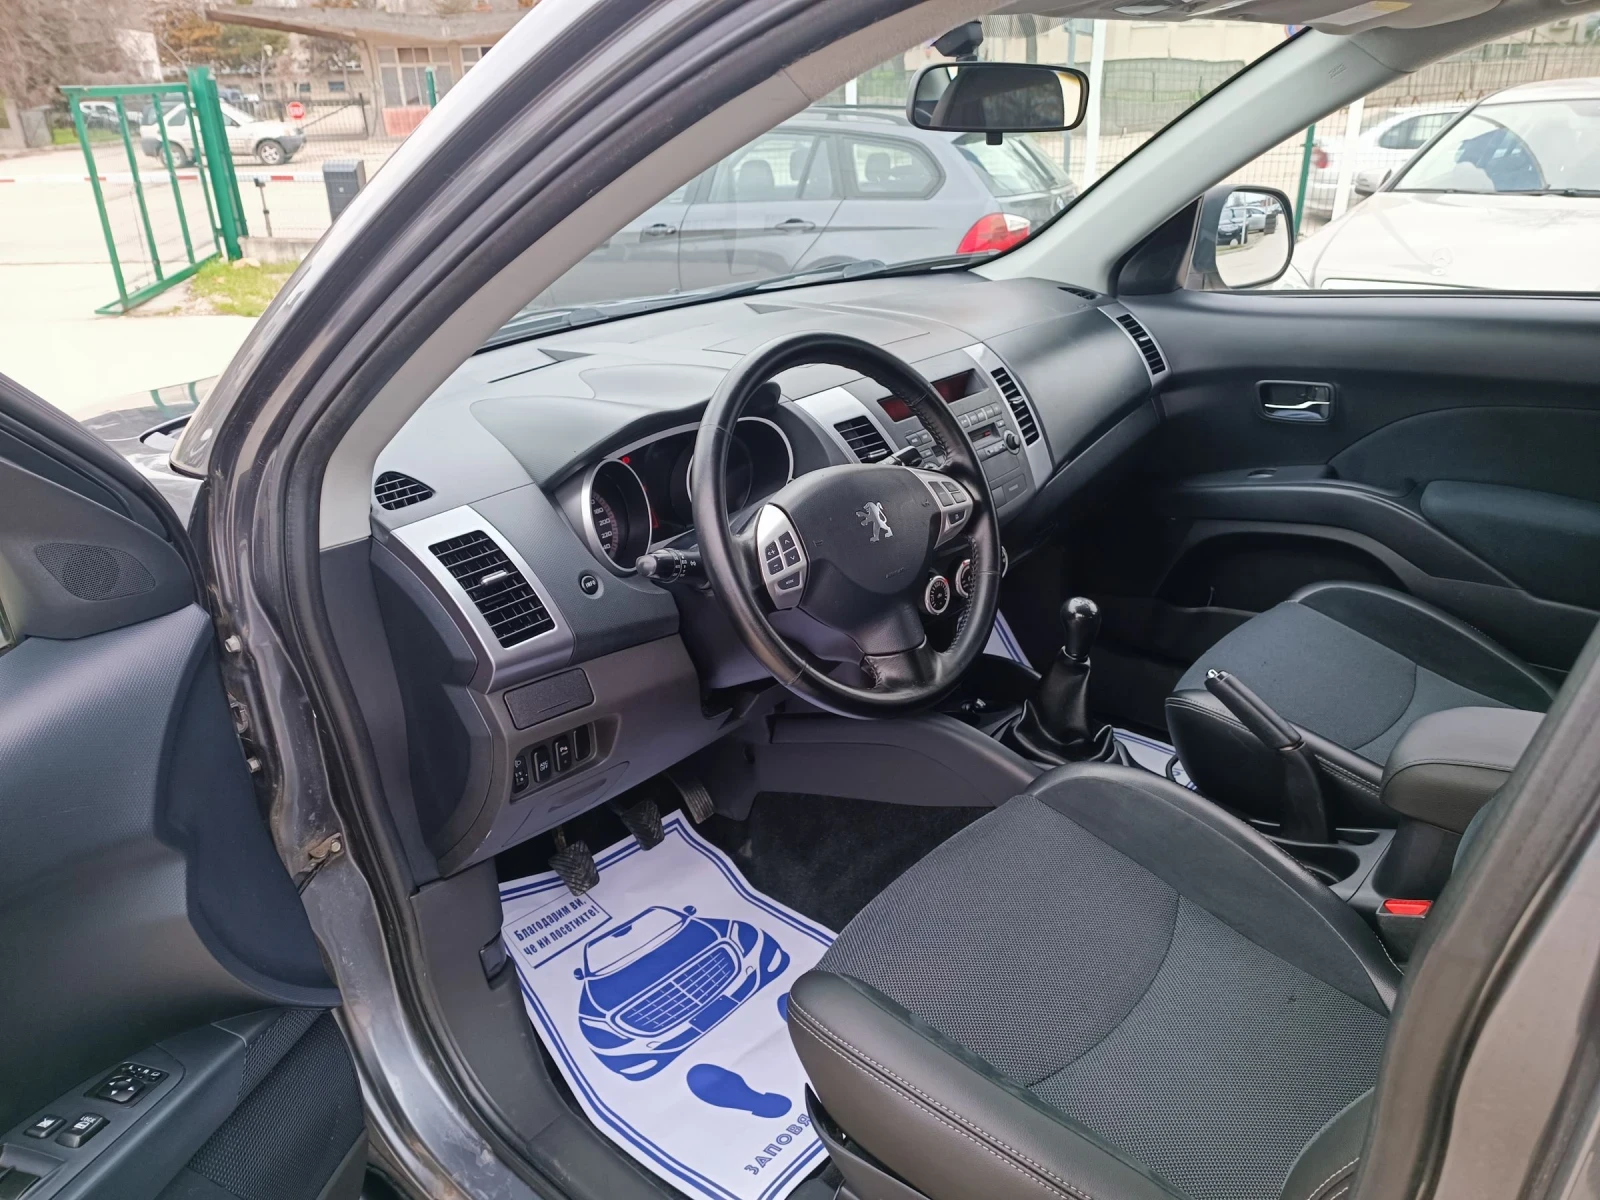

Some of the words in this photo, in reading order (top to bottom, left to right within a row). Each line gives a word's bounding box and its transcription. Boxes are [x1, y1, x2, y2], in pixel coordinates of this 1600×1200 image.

[599, 518, 611, 526] 200
[602, 530, 613, 539] 220
[513, 905, 571, 941] Благодарим
[523, 943, 538, 956] че
[536, 936, 551, 949] ни
[549, 904, 600, 941] посетихте!
